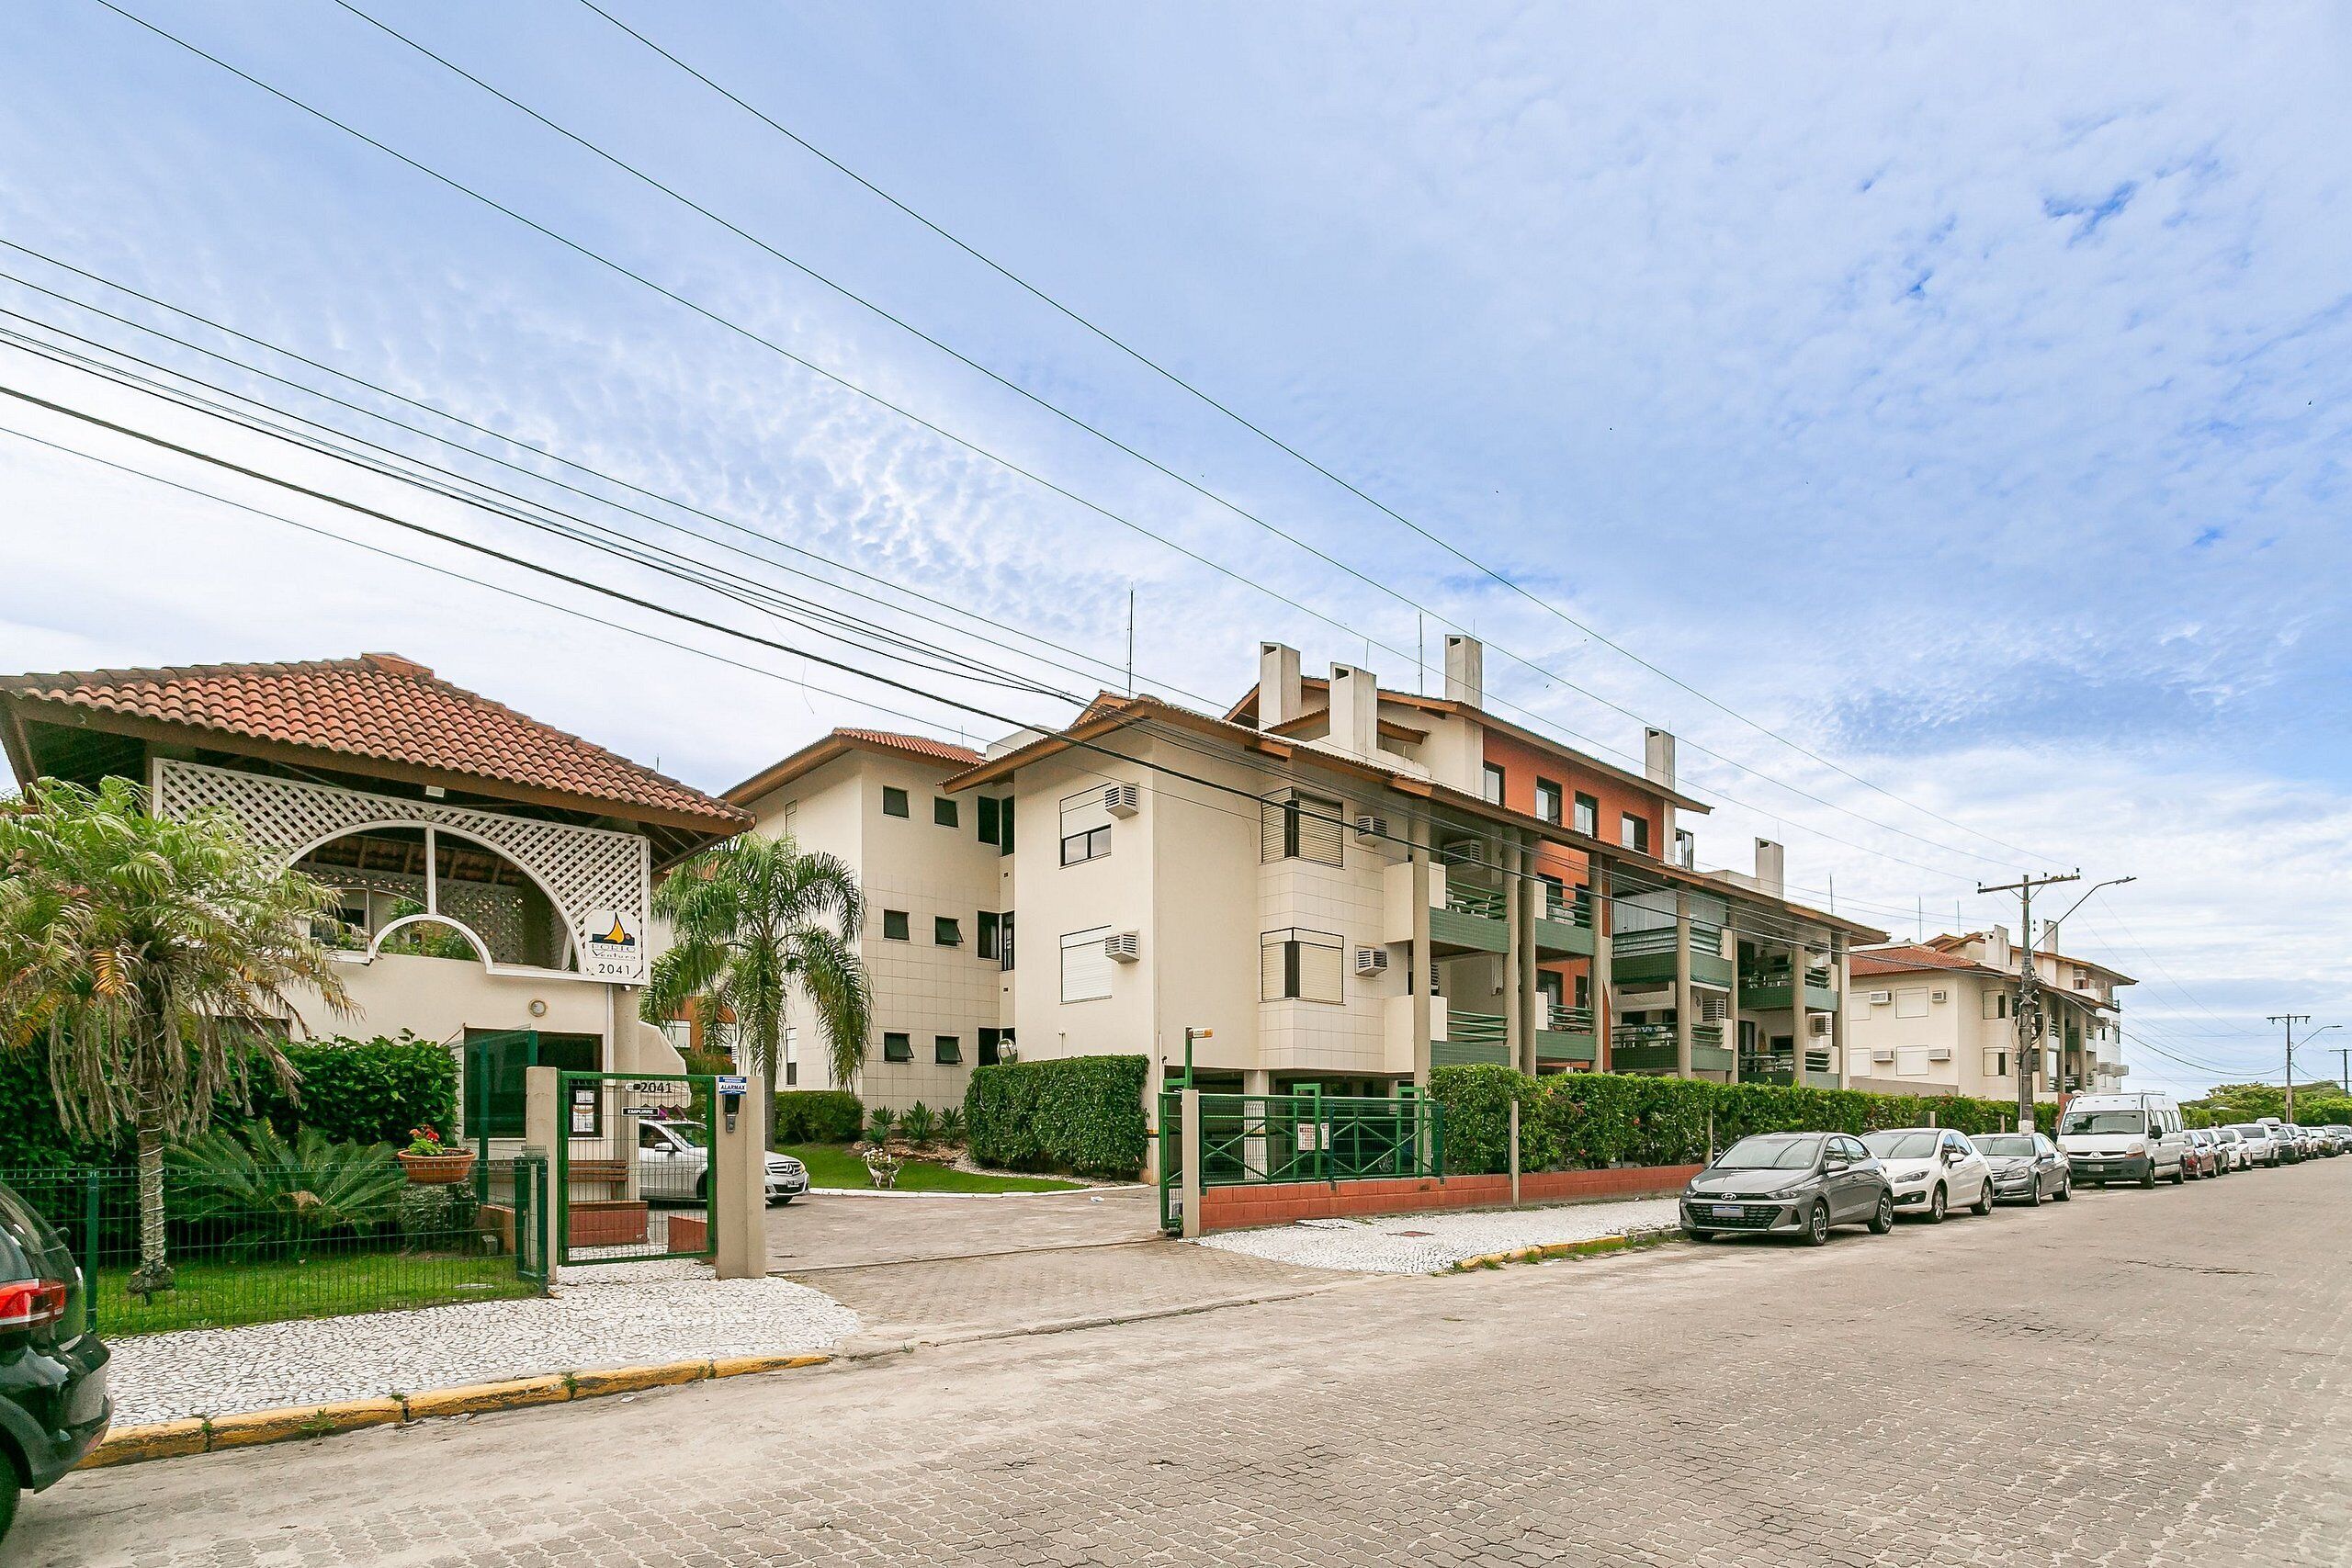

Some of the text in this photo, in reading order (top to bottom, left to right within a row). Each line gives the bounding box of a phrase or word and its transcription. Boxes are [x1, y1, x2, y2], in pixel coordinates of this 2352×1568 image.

[592, 950, 636, 959] Ventura
[598, 963, 629, 975] 2041
[640, 1082, 673, 1093] 2041
